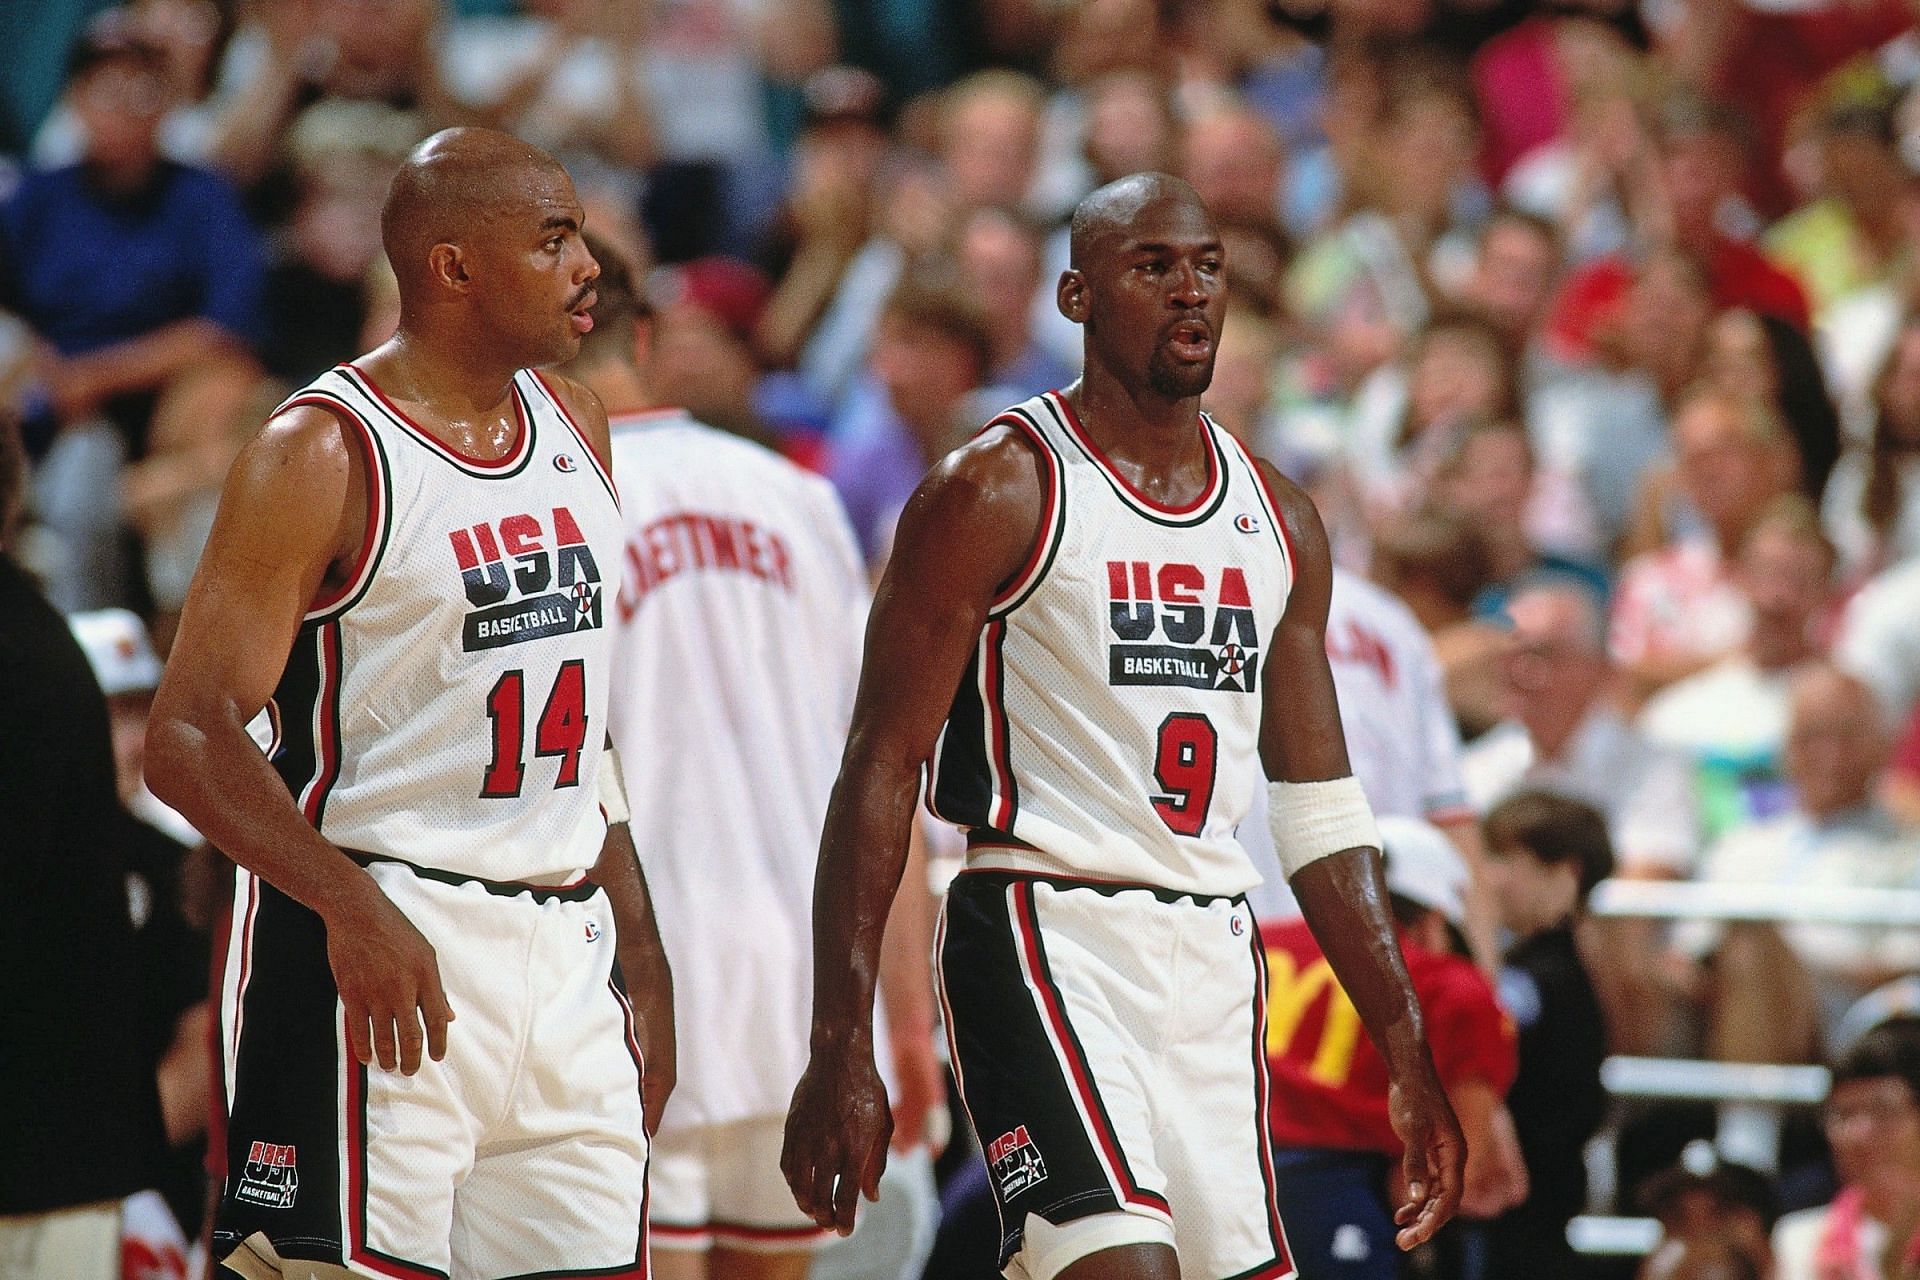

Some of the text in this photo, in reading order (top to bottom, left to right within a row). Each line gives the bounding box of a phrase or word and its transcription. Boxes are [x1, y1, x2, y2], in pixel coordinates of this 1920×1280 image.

[448, 507, 602, 607] USA
[477, 606, 568, 640] BASKETBALL
[1107, 561, 1259, 648] USA
[1123, 657, 1209, 680] BASKETBALL
[478, 658, 588, 799] 14
[1149, 711, 1218, 839] 9
[244, 1141, 298, 1187] USA
[988, 1124, 1042, 1181] USA
[241, 1185, 281, 1202] BASKETBALL
